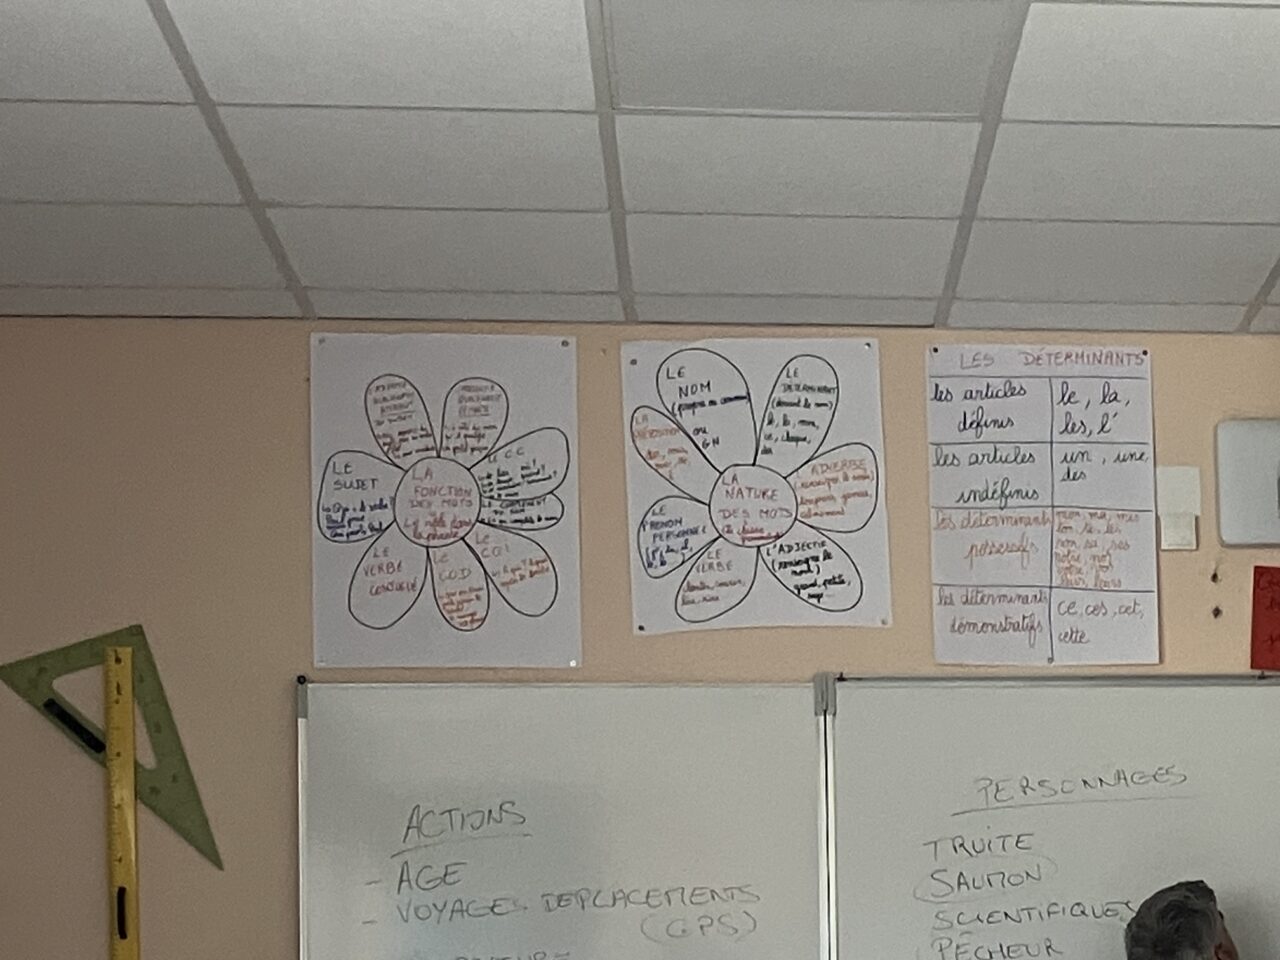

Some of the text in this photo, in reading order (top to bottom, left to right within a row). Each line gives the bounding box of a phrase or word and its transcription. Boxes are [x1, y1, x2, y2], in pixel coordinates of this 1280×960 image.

[960, 352, 995, 370] LES
[666, 366, 685, 380] LE
[785, 367, 799, 379] LE
[678, 379, 711, 399] NOM
[931, 379, 1027, 402] les articles
[957, 405, 1015, 439] définis
[932, 444, 1036, 468] les articles
[332, 461, 354, 476] LE
[412, 466, 434, 482] LA
[1060, 465, 1088, 483] des
[332, 476, 380, 492] SUJET
[721, 475, 739, 486] LA
[413, 485, 473, 500] FONCTION
[725, 486, 779, 500] NATURE
[955, 476, 1040, 511] indéfinis
[440, 496, 474, 509] MOTS
[718, 508, 794, 520] DES MOTS
[362, 560, 403, 578] VERBE
[950, 612, 1044, 649] démonstratifs
[974, 763, 1189, 805] PERSONNAGES
[401, 800, 527, 844] ACTIONS
[922, 824, 1035, 862] TRUITE
[396, 860, 468, 897] AGE
[929, 862, 1043, 899] SAUMON
[542, 883, 762, 914] DEPLACEMENTS
